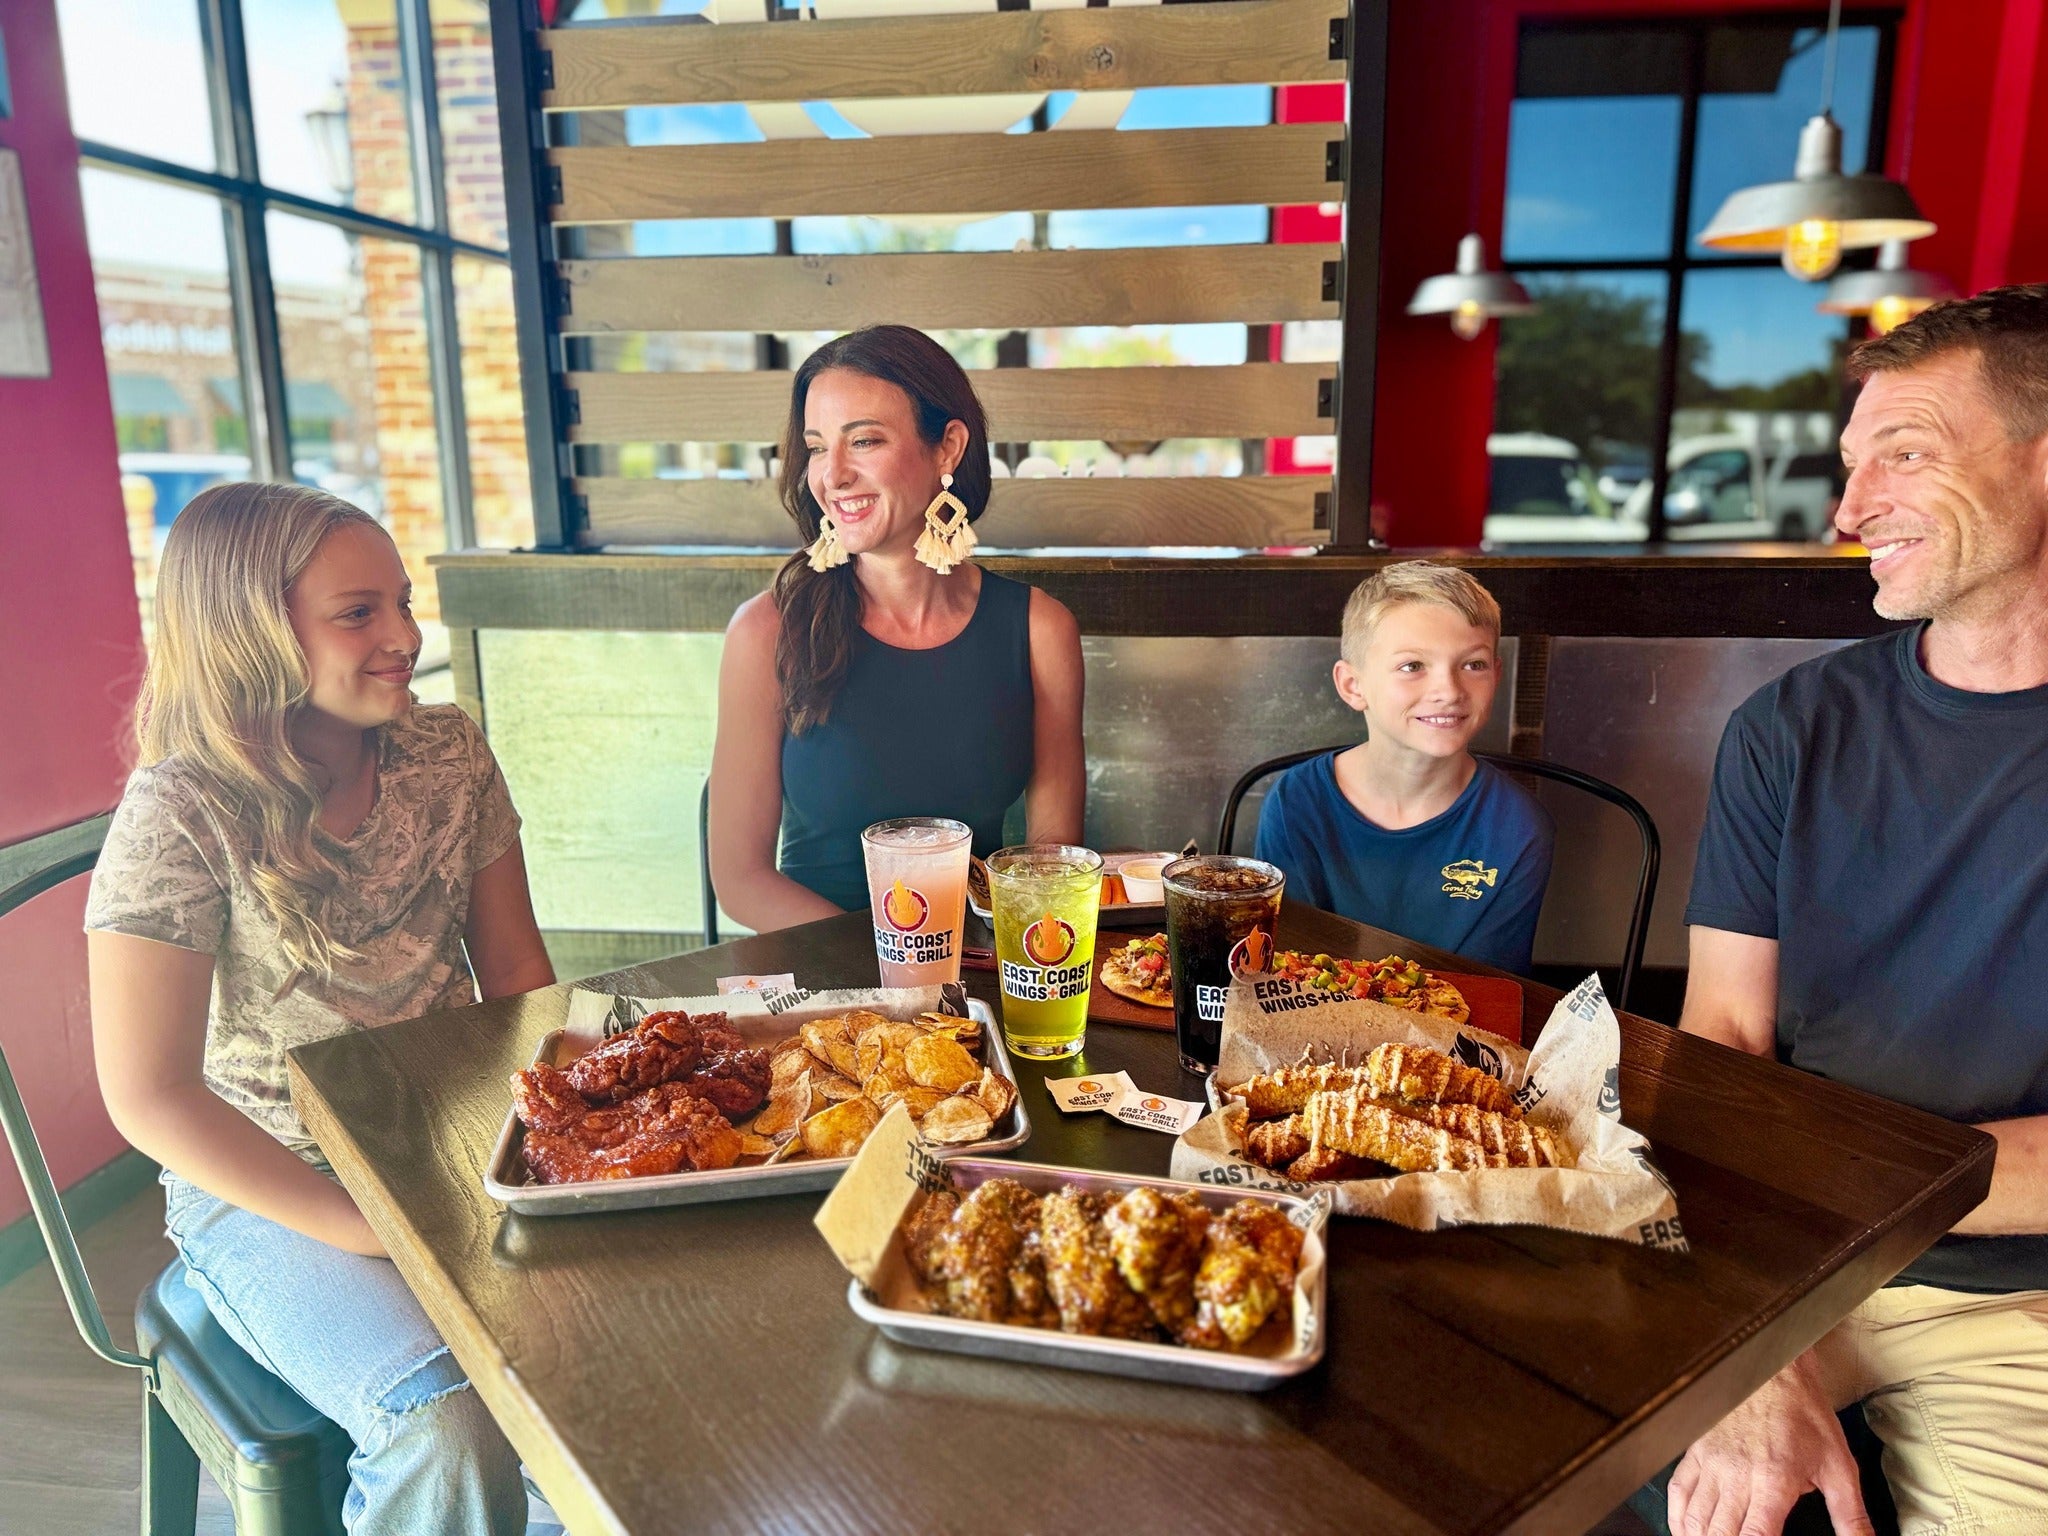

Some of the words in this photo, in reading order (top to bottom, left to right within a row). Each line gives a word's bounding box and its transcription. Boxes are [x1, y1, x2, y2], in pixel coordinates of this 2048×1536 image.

[904, 930, 953, 948] COAST
[1003, 962, 1040, 984] EAST
[1047, 961, 1091, 985] COAST
[1068, 1094, 1091, 1104] EAST
[1120, 1106, 1144, 1115] EAST
[1147, 1111, 1179, 1123] COAST
